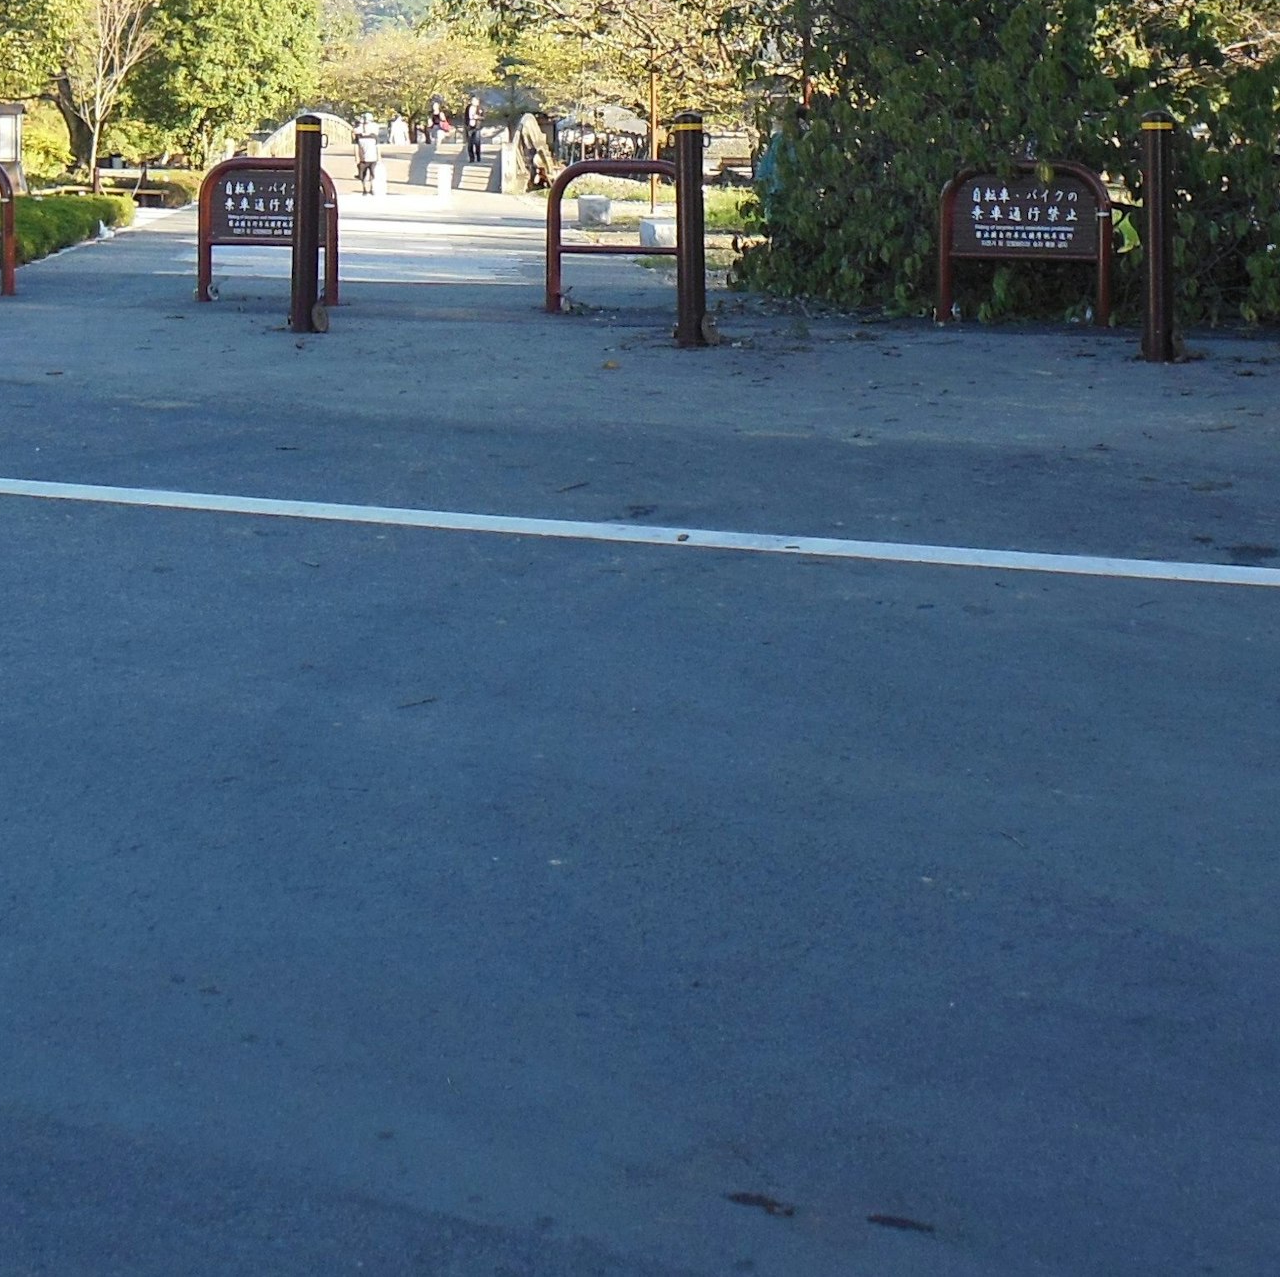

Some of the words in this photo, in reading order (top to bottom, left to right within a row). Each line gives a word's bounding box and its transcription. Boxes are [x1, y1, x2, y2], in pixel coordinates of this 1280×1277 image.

[972, 187, 1078, 204] 自転車・バイクの
[971, 205, 1078, 222] 乗車通行禁止
